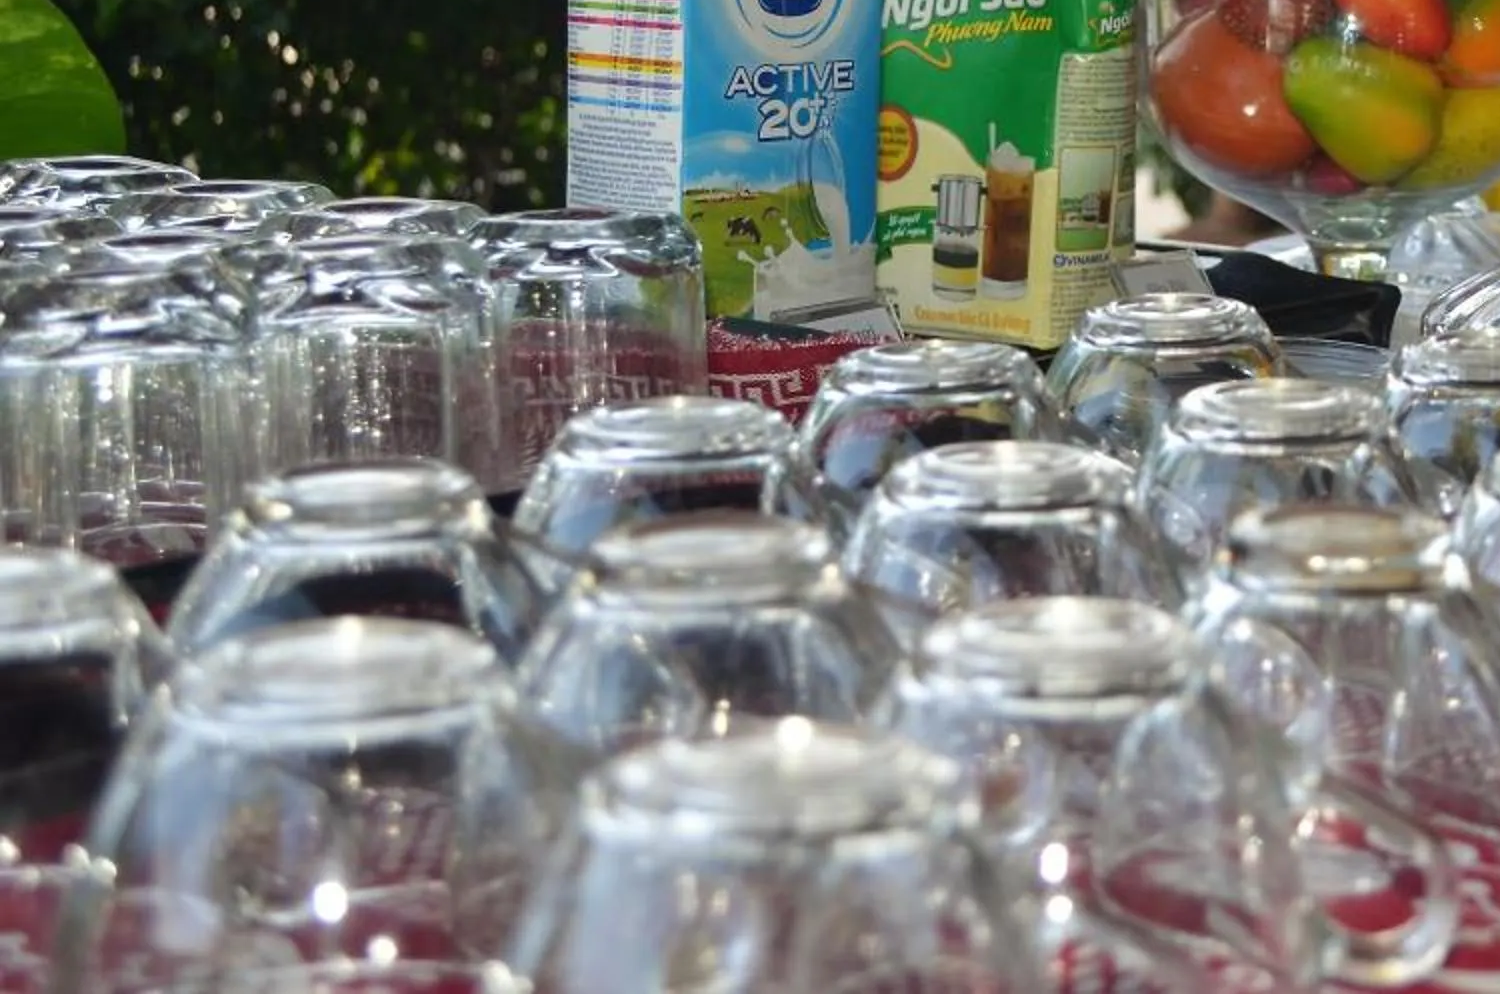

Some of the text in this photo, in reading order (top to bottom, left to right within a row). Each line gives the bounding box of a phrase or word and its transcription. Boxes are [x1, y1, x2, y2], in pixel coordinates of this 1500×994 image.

[1004, 9, 1053, 31] Nam
[724, 60, 854, 98] ACTIVE
[758, 91, 827, 142] 20+
